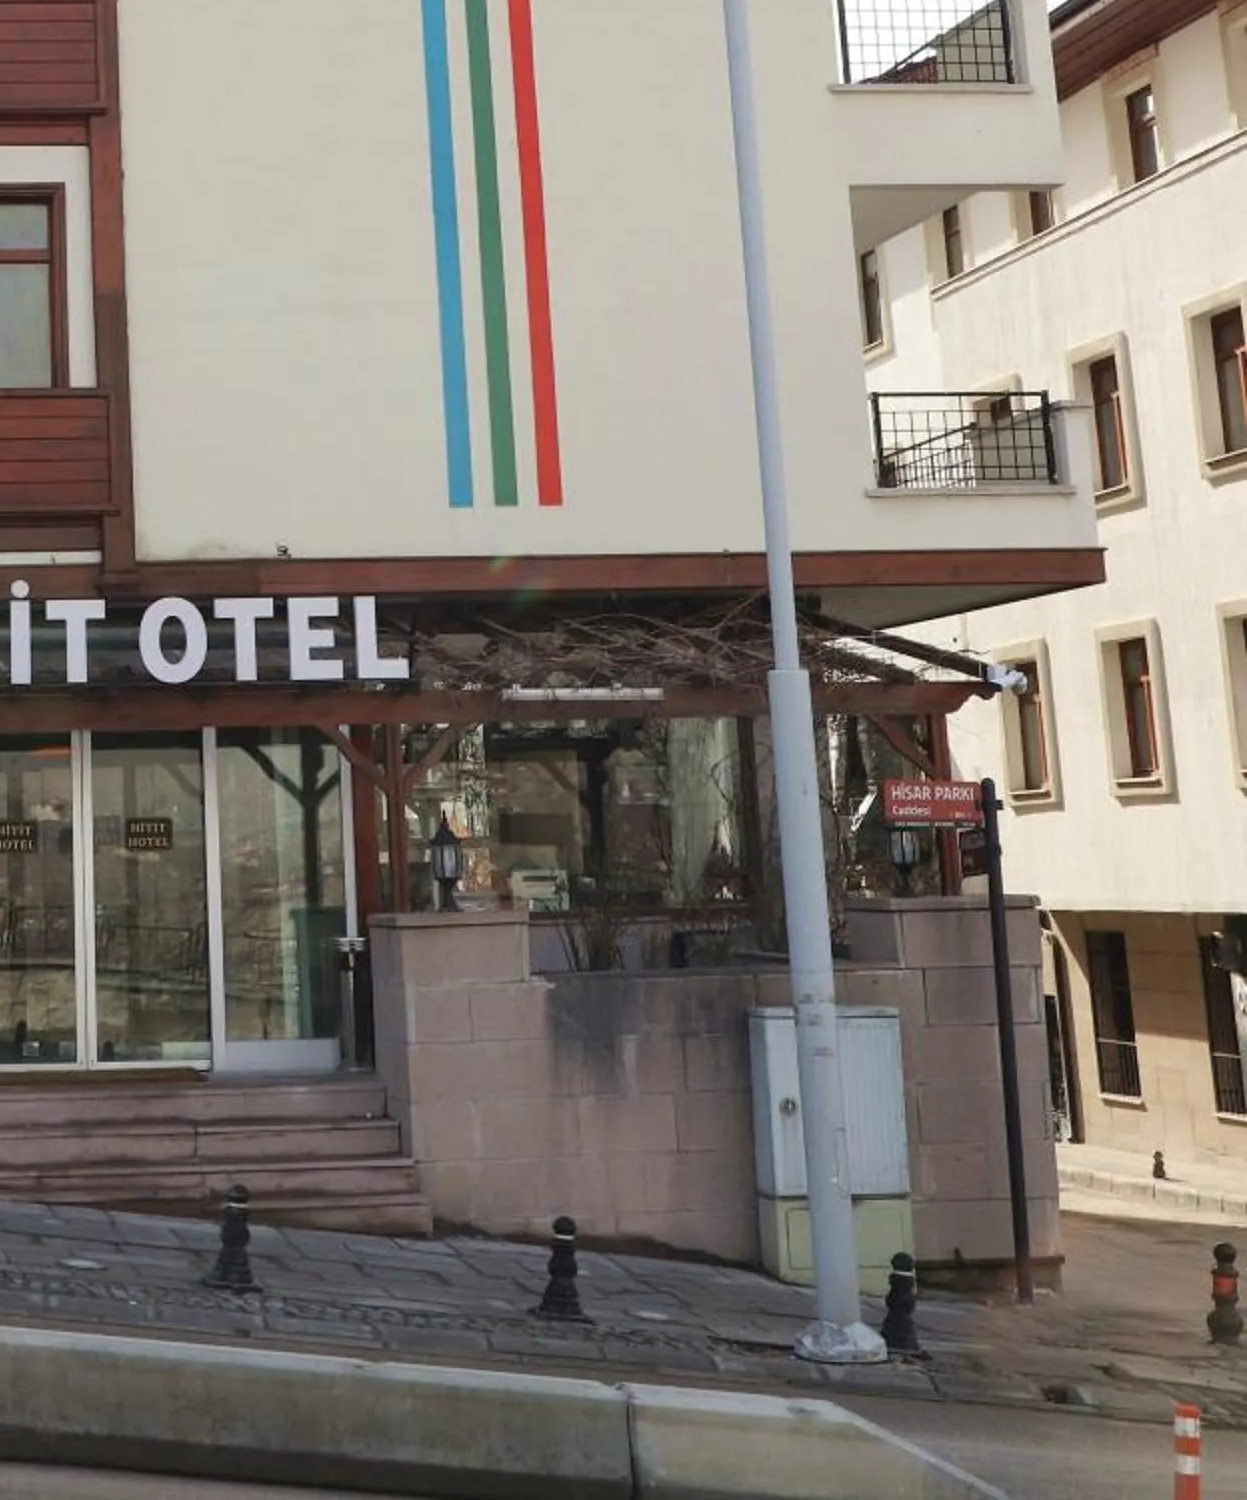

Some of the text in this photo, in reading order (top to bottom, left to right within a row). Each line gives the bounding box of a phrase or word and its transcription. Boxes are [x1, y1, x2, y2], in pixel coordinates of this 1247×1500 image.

[138, 596, 410, 684] OTEL
[934, 786, 975, 801] PARKI
[128, 837, 169, 848] HOTEL
